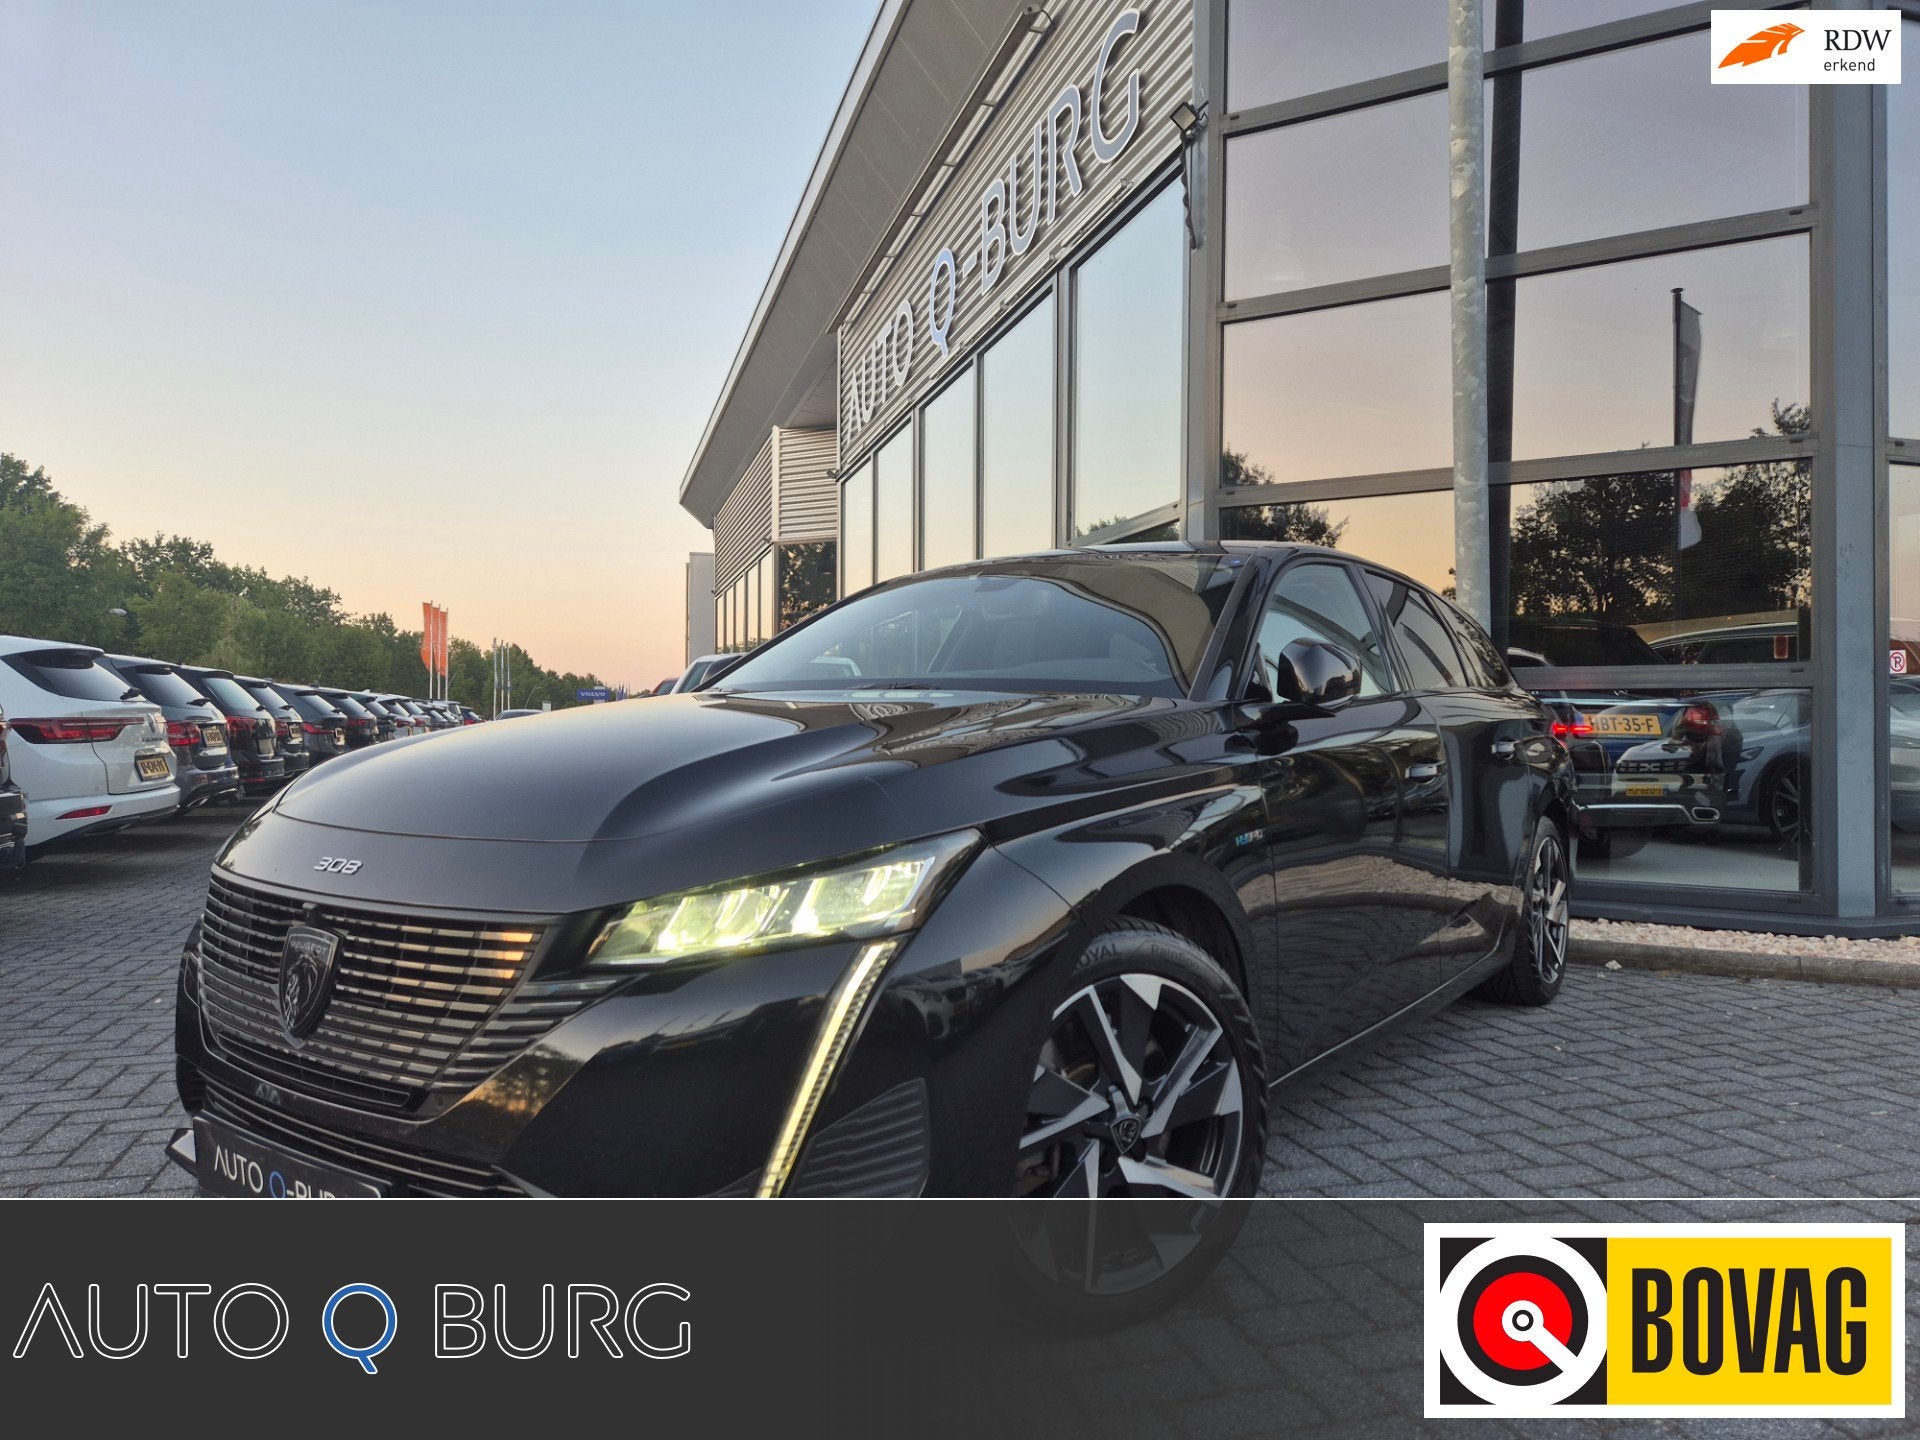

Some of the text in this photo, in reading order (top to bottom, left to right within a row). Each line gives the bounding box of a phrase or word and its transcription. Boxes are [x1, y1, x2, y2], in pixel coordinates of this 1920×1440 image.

[845, 7, 1141, 445] AUTO Q-BURG
[579, 690, 606, 698] VOLVO
[313, 856, 363, 875] 308
[290, 940, 328, 955] PEUGEOT
[213, 1144, 264, 1194] AUTO
